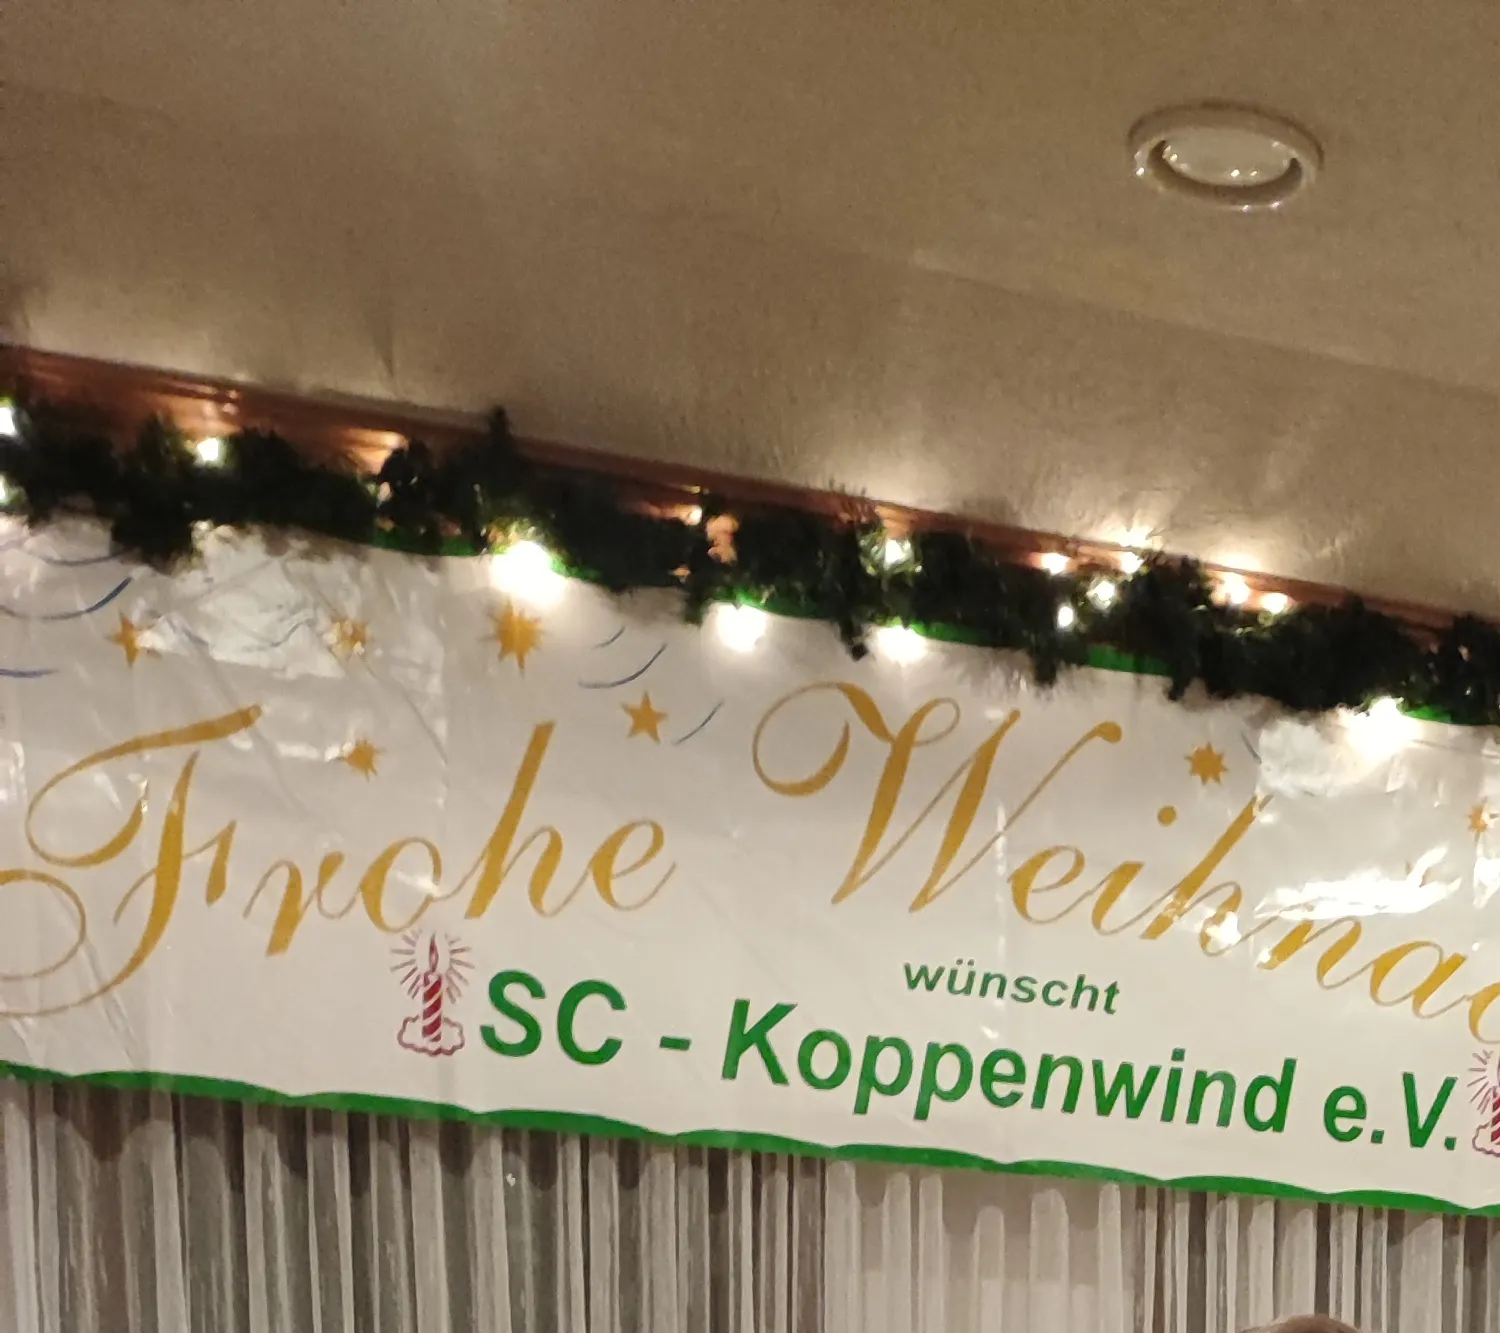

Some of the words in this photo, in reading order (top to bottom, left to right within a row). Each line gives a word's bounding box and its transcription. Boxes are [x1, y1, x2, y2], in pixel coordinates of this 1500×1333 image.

[0, 703, 677, 1017] Frohe
[479, 970, 628, 1066] SC
[659, 1033, 692, 1052] -
[720, 999, 1297, 1134] Koppenwind
[1321, 1071, 1459, 1152] e.V.
[904, 958, 1120, 1015] wünscht
